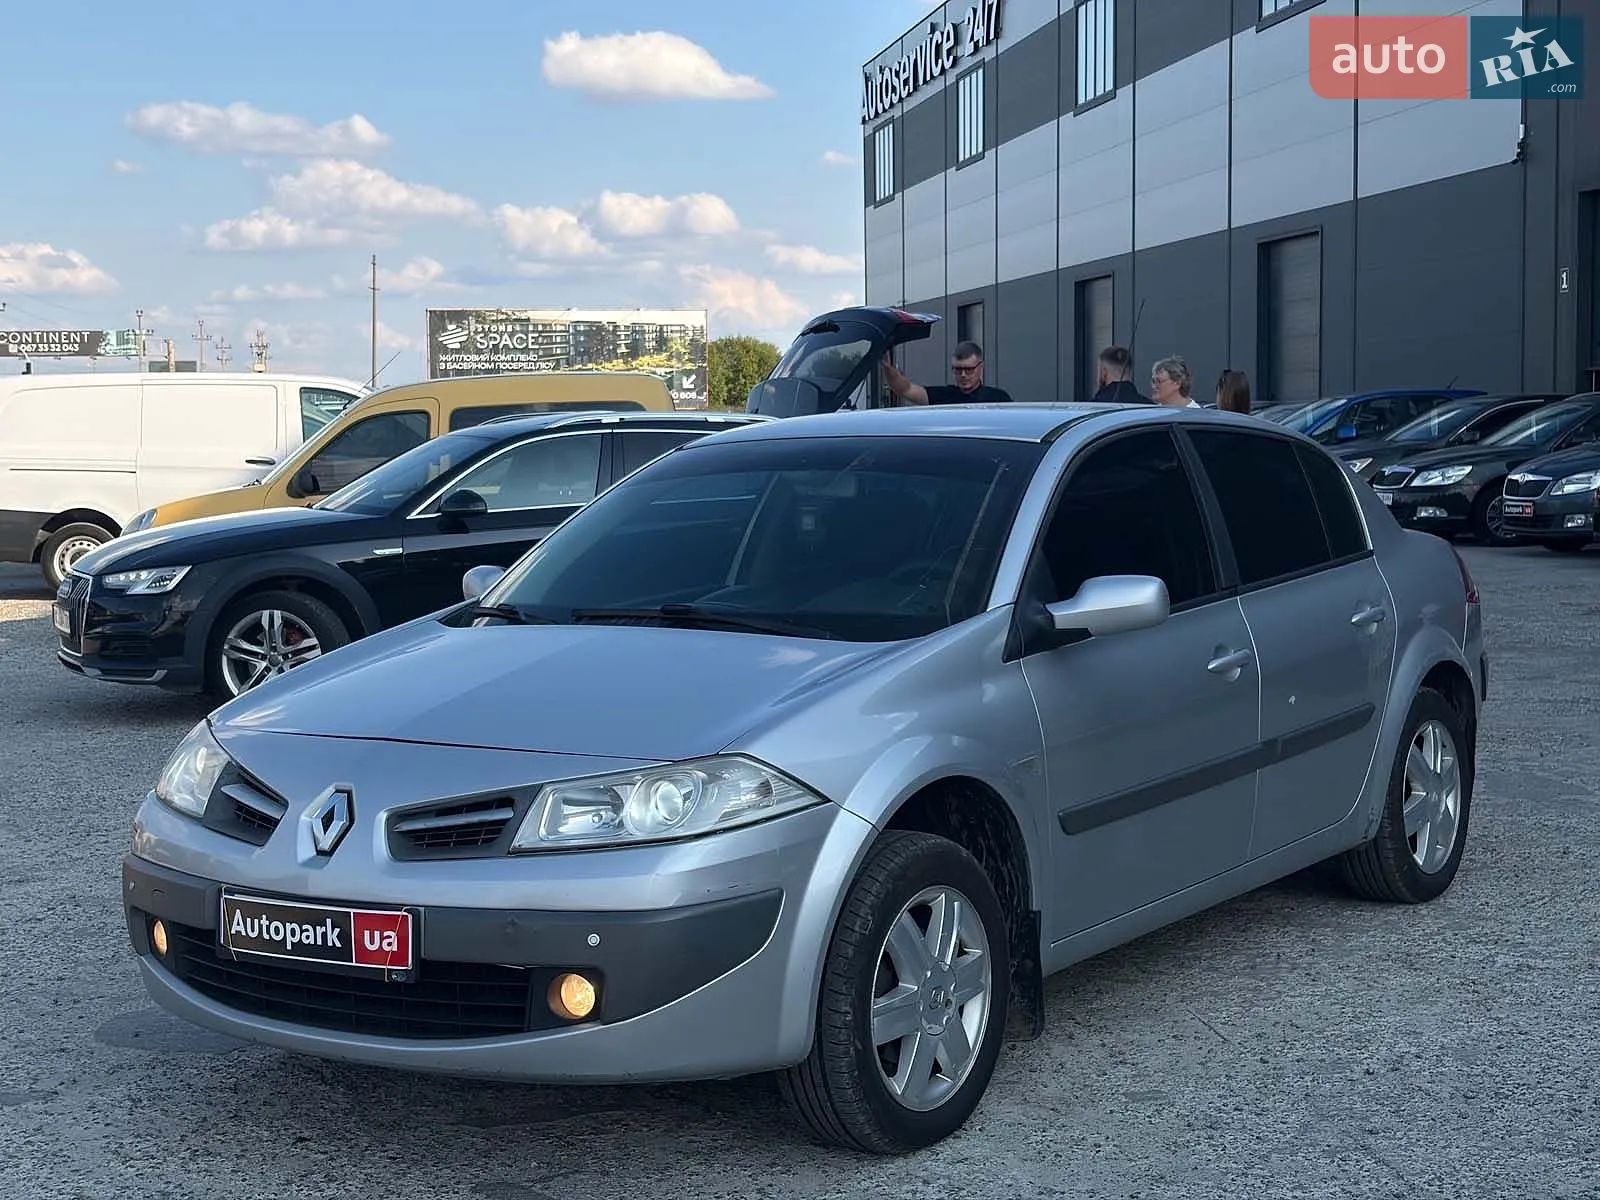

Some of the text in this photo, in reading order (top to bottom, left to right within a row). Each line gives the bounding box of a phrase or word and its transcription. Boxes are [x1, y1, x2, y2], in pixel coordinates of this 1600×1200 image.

[862, 0, 1001, 122] Autoservice 24/7
[1561, 271, 1568, 289] 1
[0, 331, 90, 344] CONTINENT
[475, 333, 540, 349] SPACE
[439, 353, 490, 362] ЖИТЛОВИЙ
[447, 361, 495, 370] БАСЕЙНОМ
[495, 362, 536, 371] ПОСЕРЕД
[230, 908, 398, 952] Autopark ua
